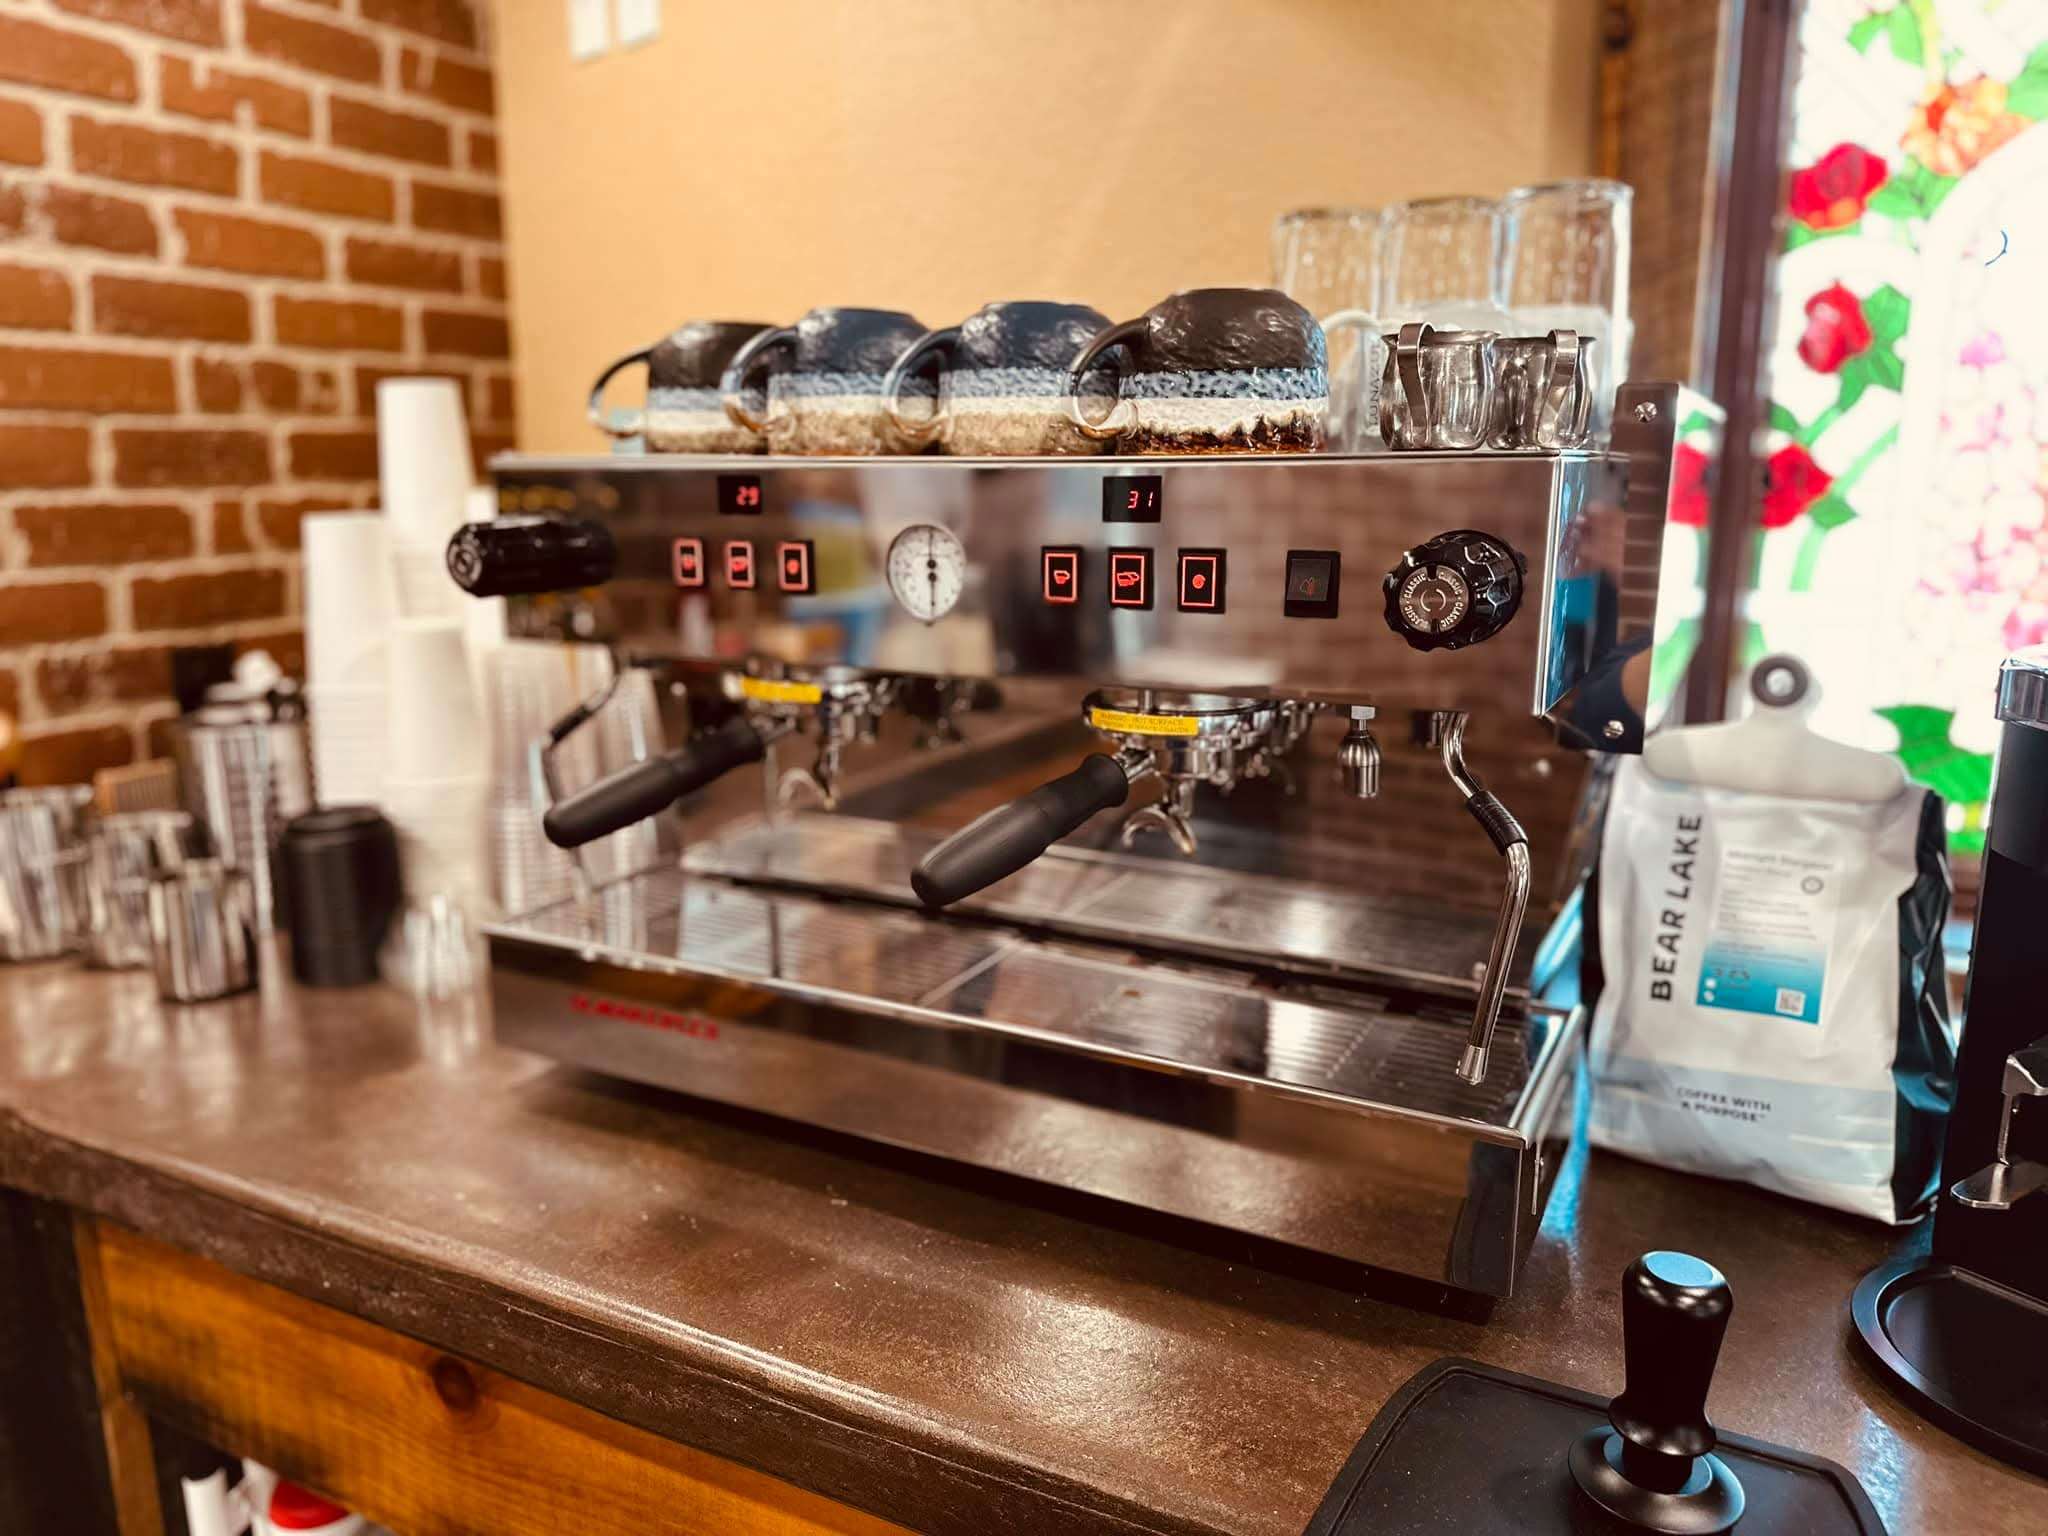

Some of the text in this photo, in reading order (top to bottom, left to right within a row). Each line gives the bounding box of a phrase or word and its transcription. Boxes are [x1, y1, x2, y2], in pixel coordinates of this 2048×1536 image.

[1127, 490, 1154, 509] 31
[1403, 573, 1427, 599] CLASSIC
[1440, 601, 1464, 627] CLASSIC
[1650, 815, 1702, 1001] BEAR LAKE
[1732, 1096, 1771, 1112] WITH
